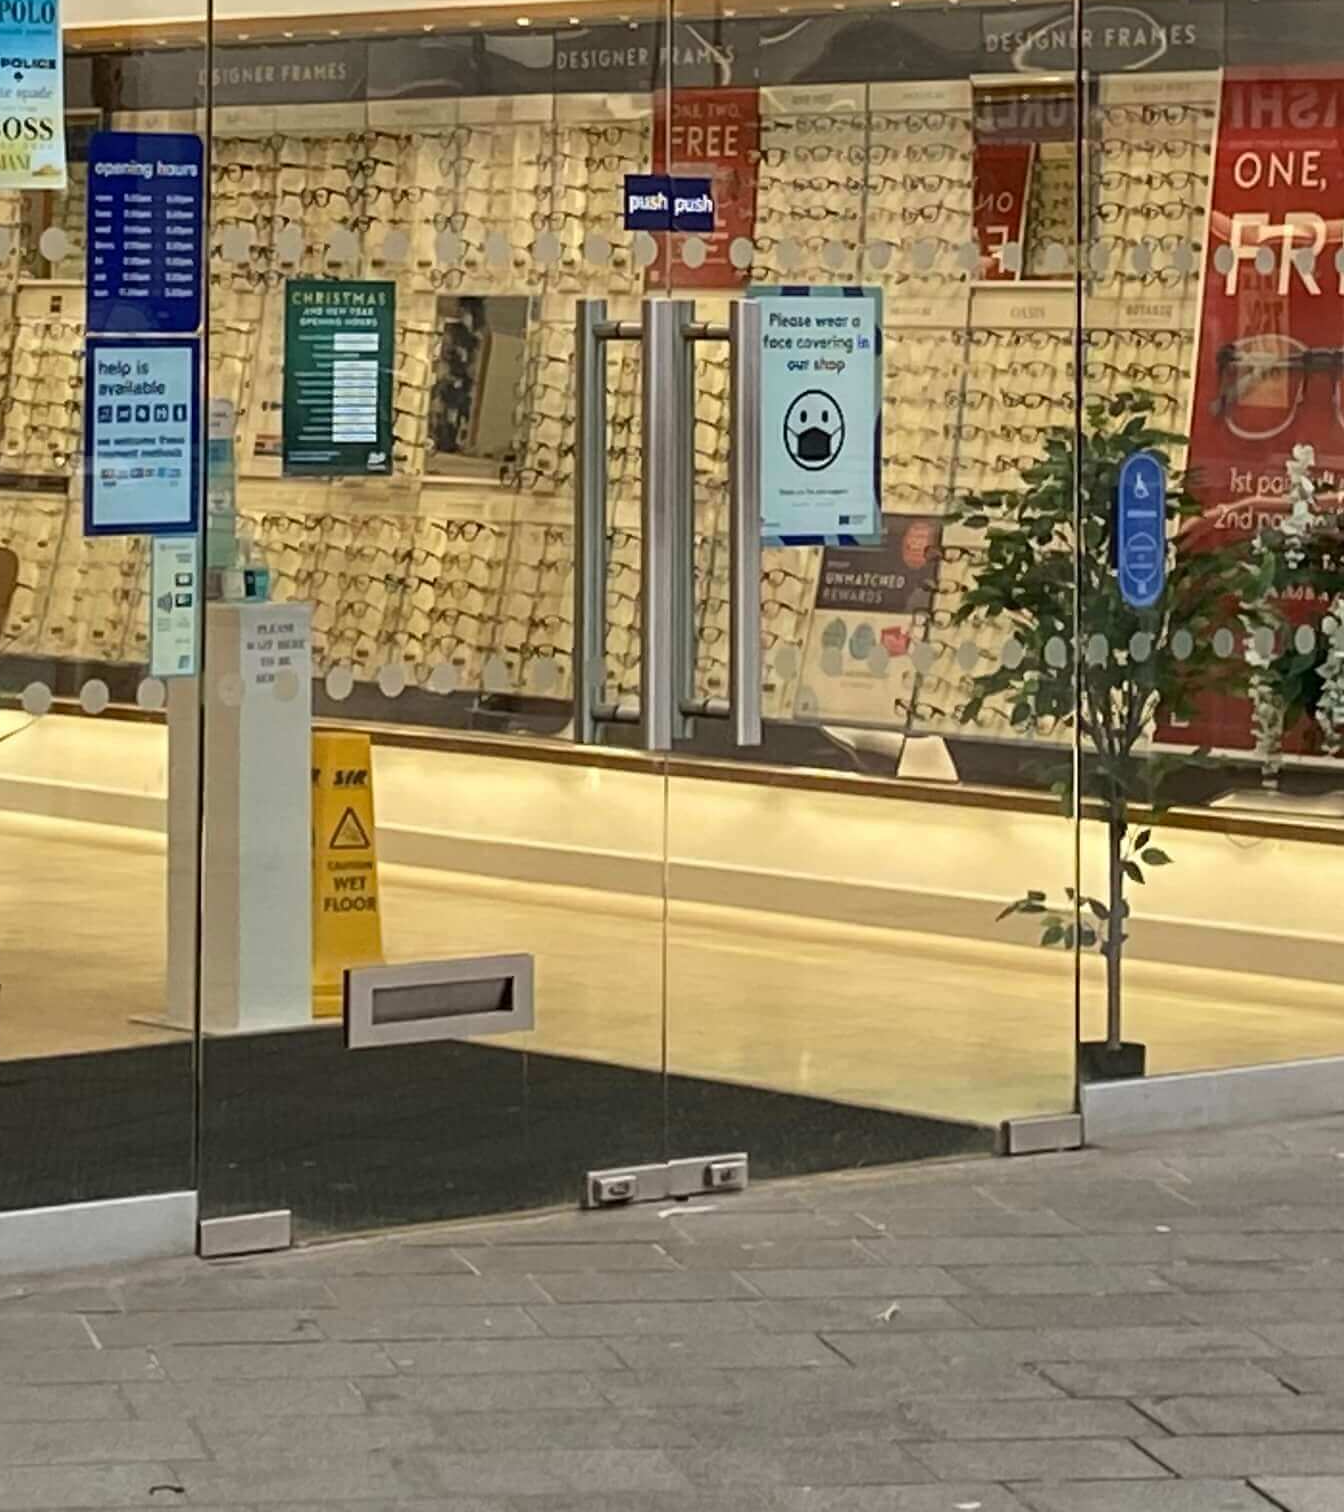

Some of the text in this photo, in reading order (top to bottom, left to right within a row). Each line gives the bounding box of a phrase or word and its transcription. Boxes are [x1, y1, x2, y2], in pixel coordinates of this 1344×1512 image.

[557, 47, 649, 70] DESIGNER
[94, 160, 199, 180] opening hours
[1233, 151, 1328, 191] ONE,
[629, 192, 668, 215] push
[674, 194, 714, 217] push
[291, 291, 387, 307] CHRISTMAS
[768, 313, 861, 328] Please wear a
[763, 334, 870, 354] face covering in
[98, 360, 150, 377] help is
[786, 356, 846, 375] our shop
[98, 379, 166, 396] available
[1214, 503, 1254, 529] 2nd
[333, 875, 367, 891] WET
[323, 896, 377, 913] FLOOR
